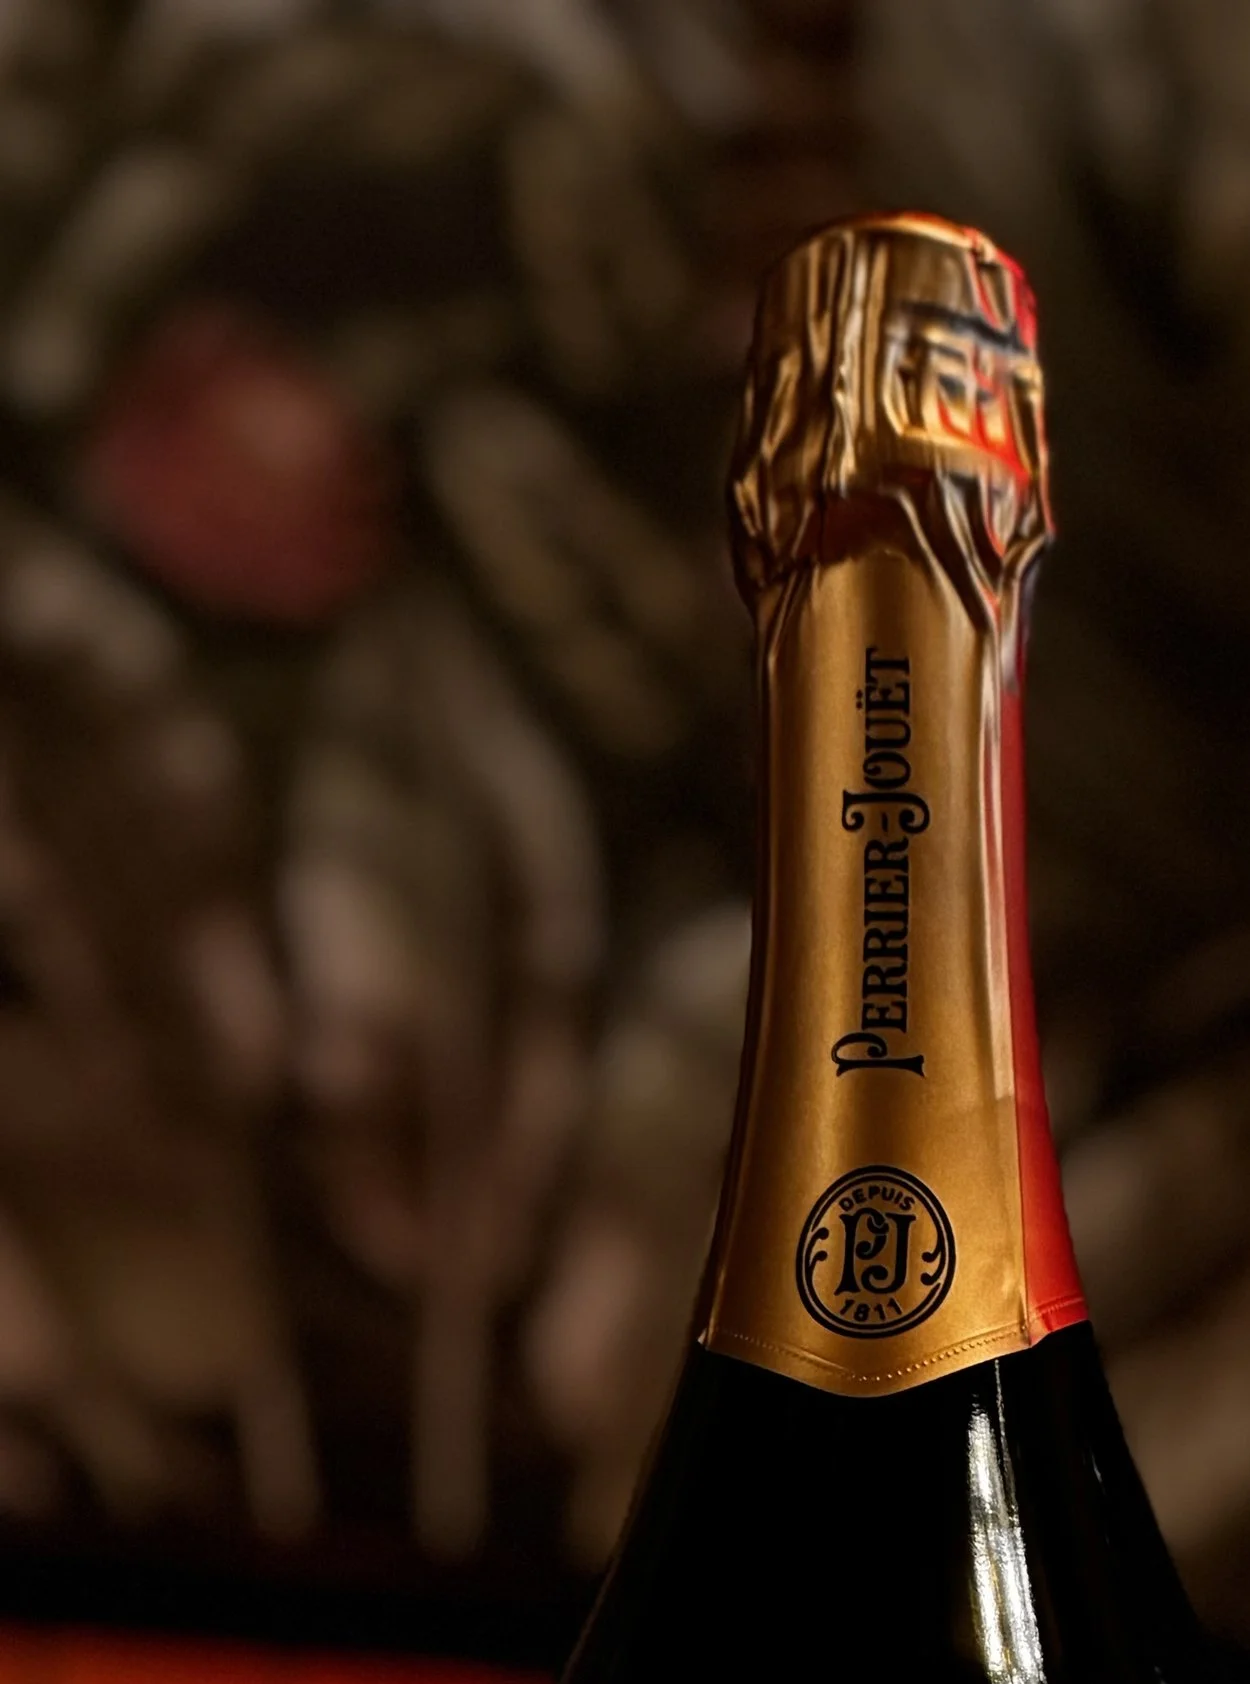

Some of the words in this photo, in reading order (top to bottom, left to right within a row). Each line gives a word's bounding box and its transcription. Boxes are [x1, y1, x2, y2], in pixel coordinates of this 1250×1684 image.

[839, 1185, 915, 1211] DEPUIS
[834, 1207, 916, 1295] PJ
[840, 1297, 902, 1322] 1811
